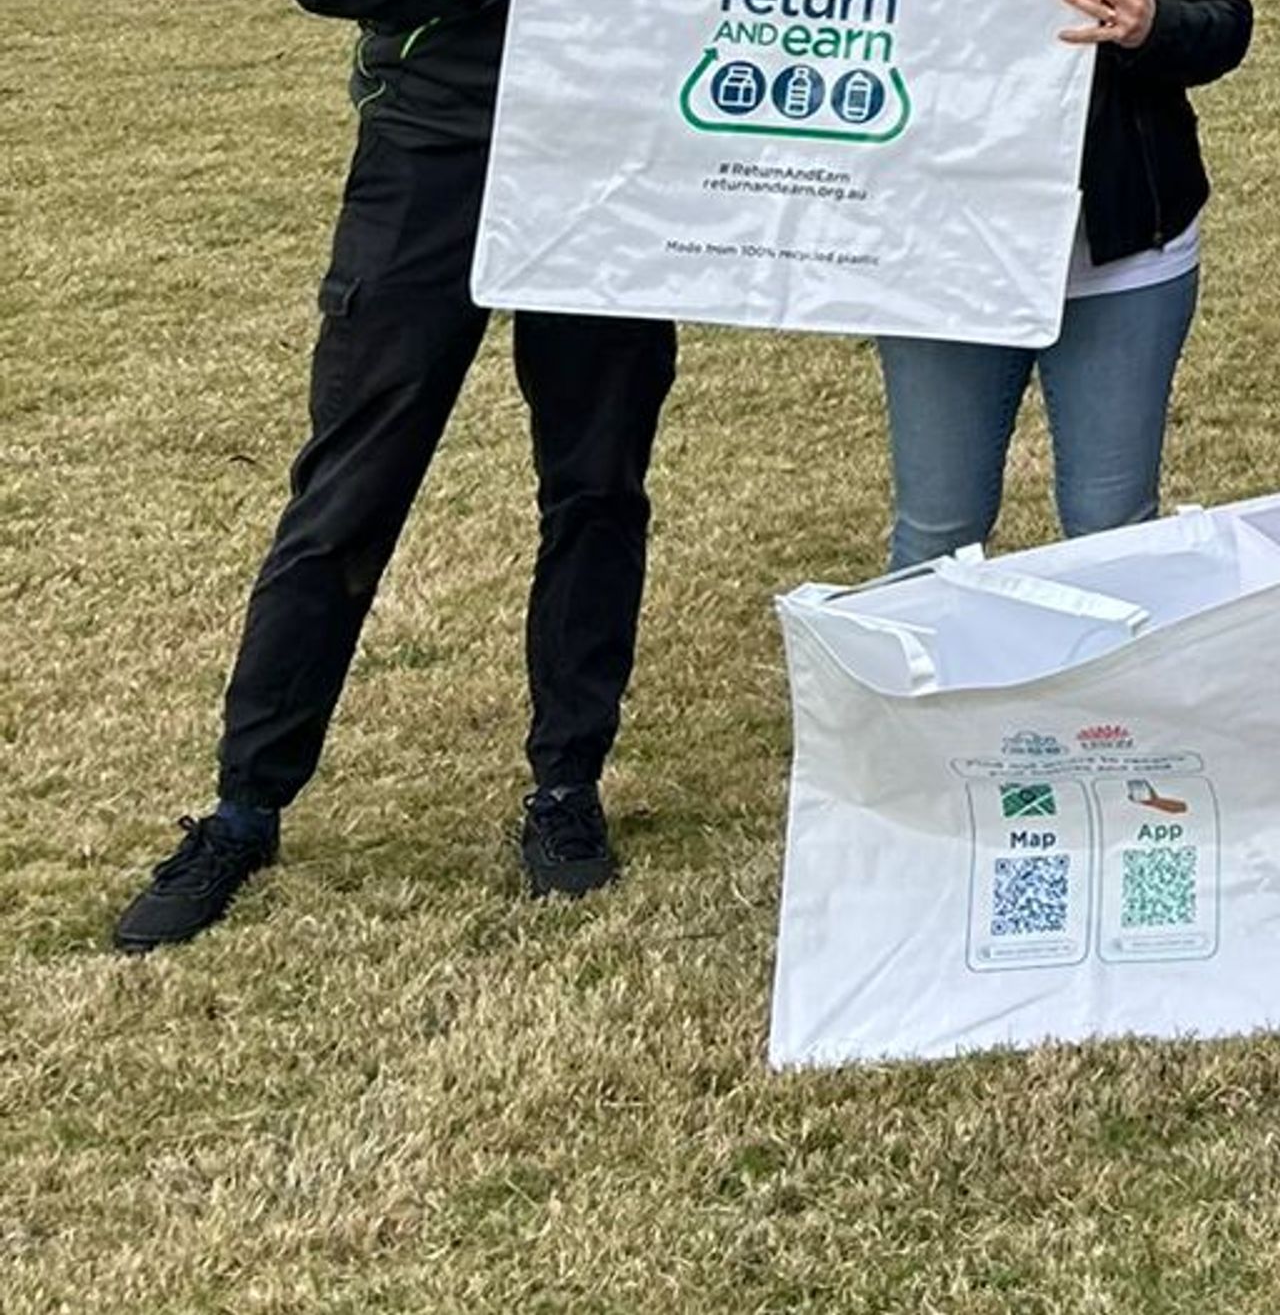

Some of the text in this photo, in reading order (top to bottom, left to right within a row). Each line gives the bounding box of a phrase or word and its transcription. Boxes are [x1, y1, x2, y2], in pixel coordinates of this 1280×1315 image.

[713, 20, 893, 63] AND earn
[666, 240, 700, 254] Made
[706, 242, 738, 255] from
[742, 245, 776, 259] 100%
[837, 252, 879, 267] plastic
[1010, 831, 1056, 850] Map
[1138, 824, 1183, 842] App
